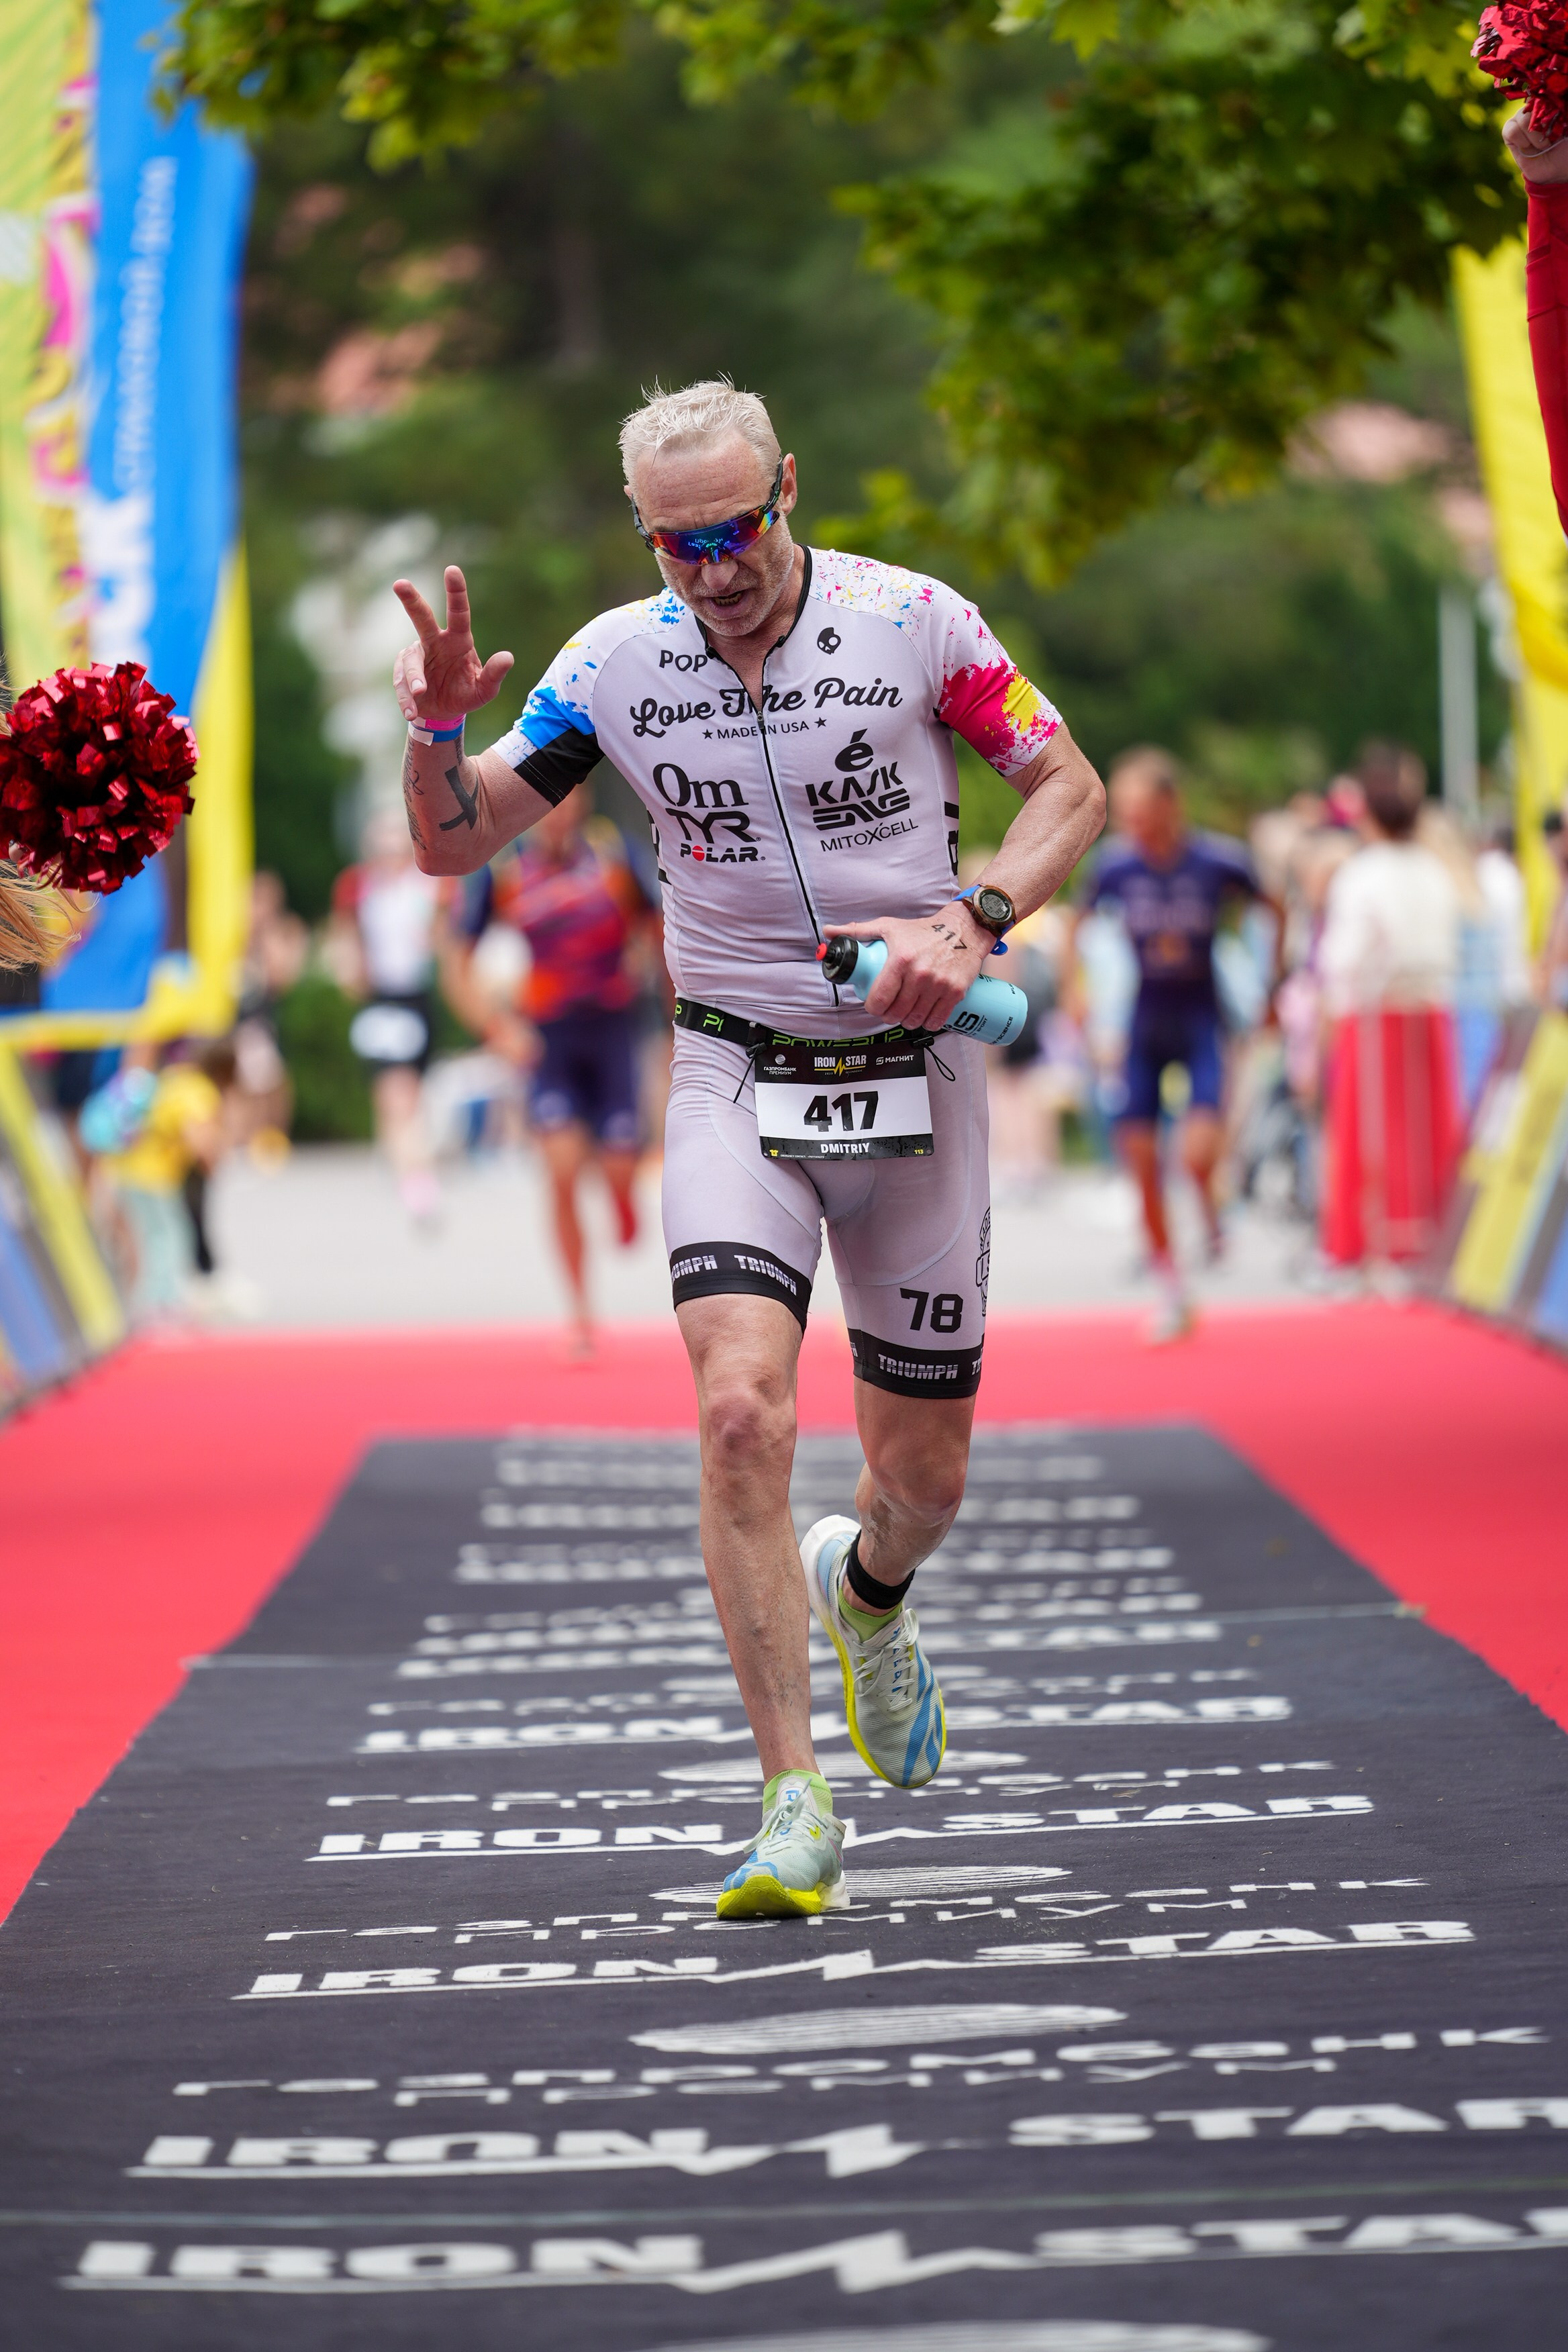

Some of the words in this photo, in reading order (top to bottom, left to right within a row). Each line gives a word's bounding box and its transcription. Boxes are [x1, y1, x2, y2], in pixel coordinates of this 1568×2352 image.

[658, 649, 707, 673] POP
[630, 697, 716, 738] Love
[719, 684, 807, 718] The
[814, 677, 903, 709] Pain
[717, 726, 758, 740] MADE
[764, 724, 777, 736] IN
[781, 720, 810, 734] USA
[652, 763, 749, 808] Om
[805, 761, 903, 807] KASK
[665, 807, 757, 844] TYR
[820, 818, 919, 852] MITOXCELL
[680, 842, 758, 863] POLAR
[931, 923, 968, 950] 417
[814, 1057, 836, 1067] IRON
[845, 1055, 867, 1066] STAR
[885, 1055, 914, 1063] МАГНИТ
[803, 1090, 879, 1132] 417
[820, 1142, 870, 1155] DMITRIY
[734, 1255, 797, 1296] TRIUMPH
[899, 1287, 964, 1333] 78
[877, 1353, 959, 1380] TRIUMPH
[319, 1824, 723, 1854] IRON
[942, 1795, 1374, 1830] STAR
[250, 1956, 718, 1994] IRON
[973, 1920, 1475, 1961] STAR
[142, 2127, 708, 2166] IRON
[77, 2233, 703, 2280] IRON
[1036, 2206, 1568, 2257] STA
